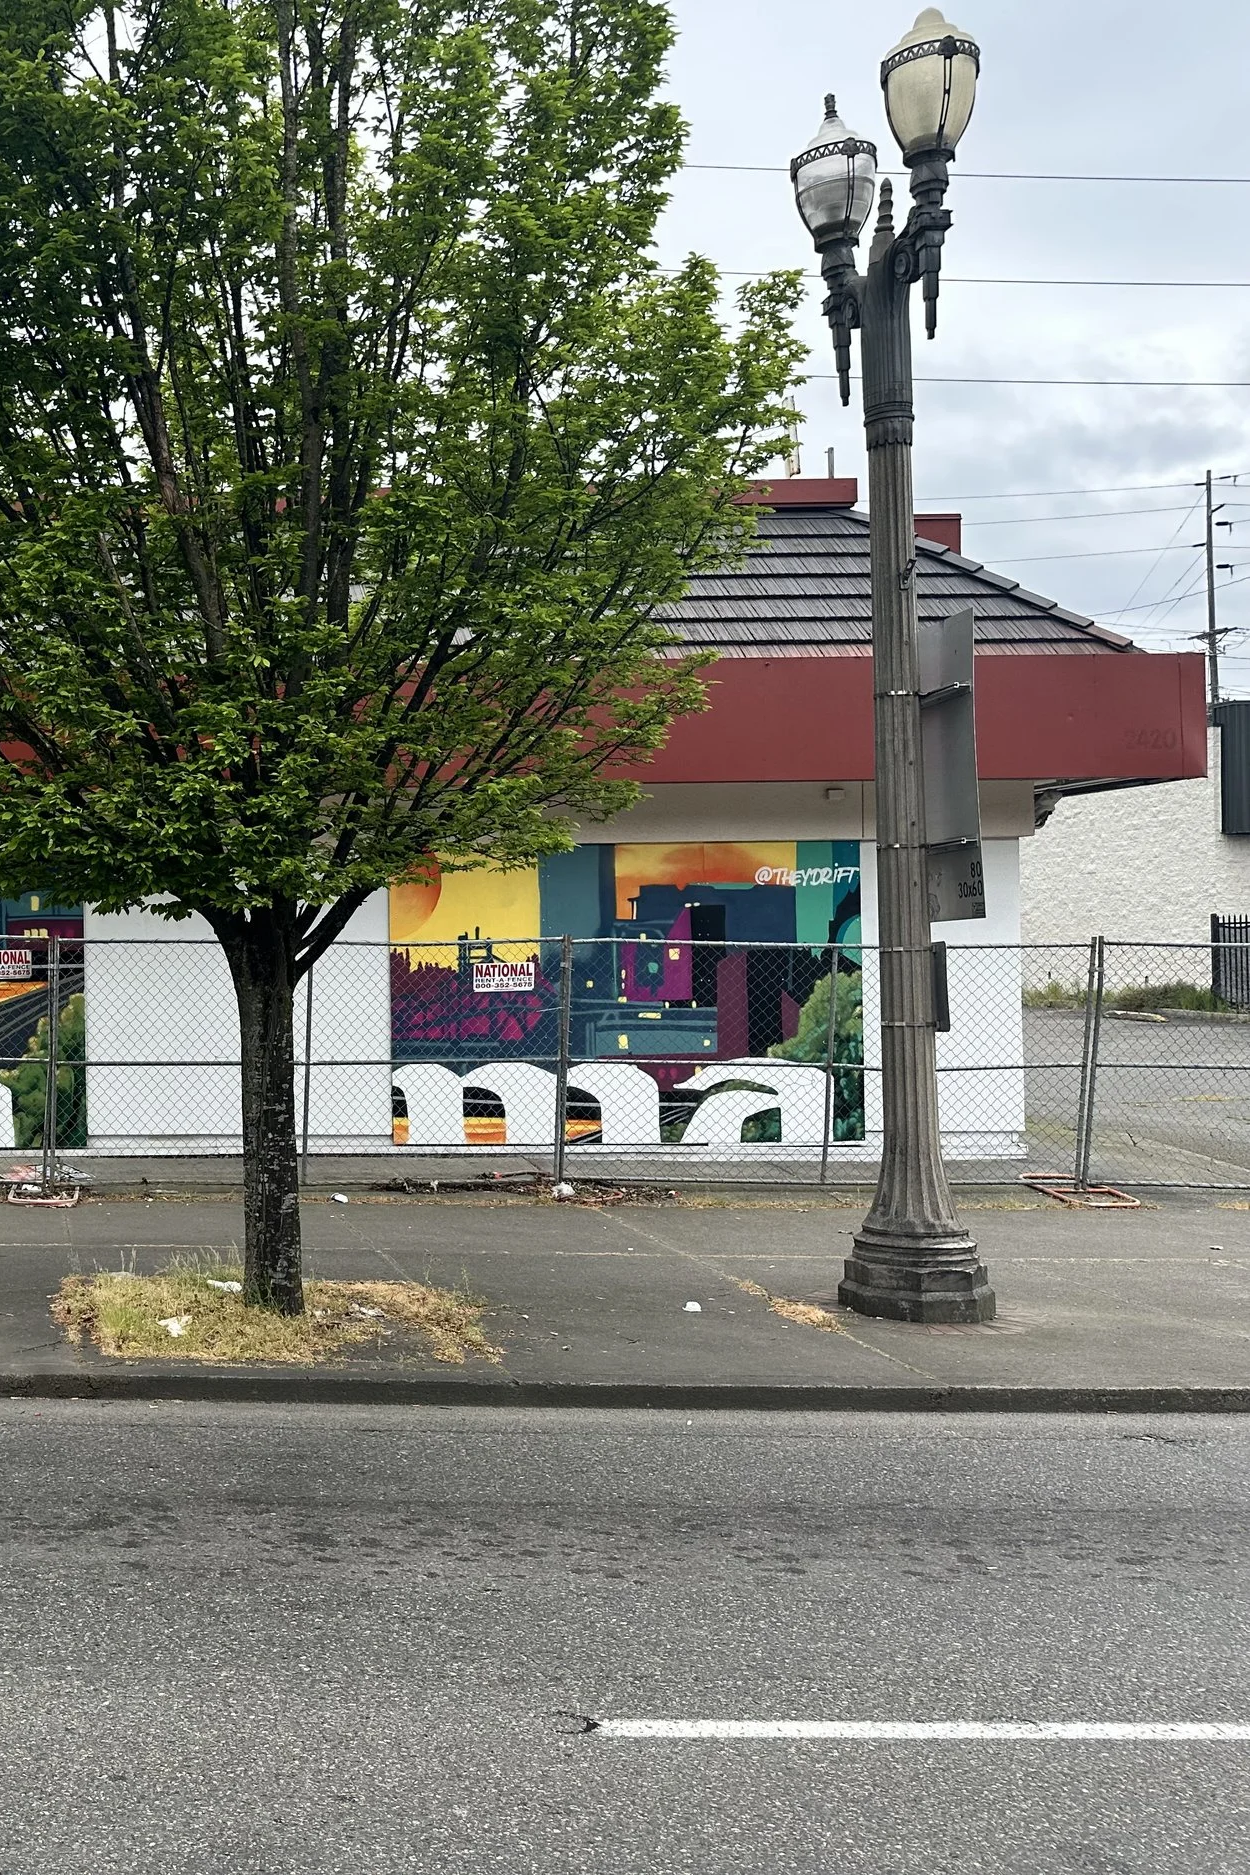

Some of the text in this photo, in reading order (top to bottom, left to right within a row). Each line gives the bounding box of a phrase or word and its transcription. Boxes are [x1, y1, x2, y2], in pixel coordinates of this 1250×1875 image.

[970, 861, 982, 878] 80
[958, 880, 983, 899] 30x60
[475, 963, 533, 978] NATIONAL
